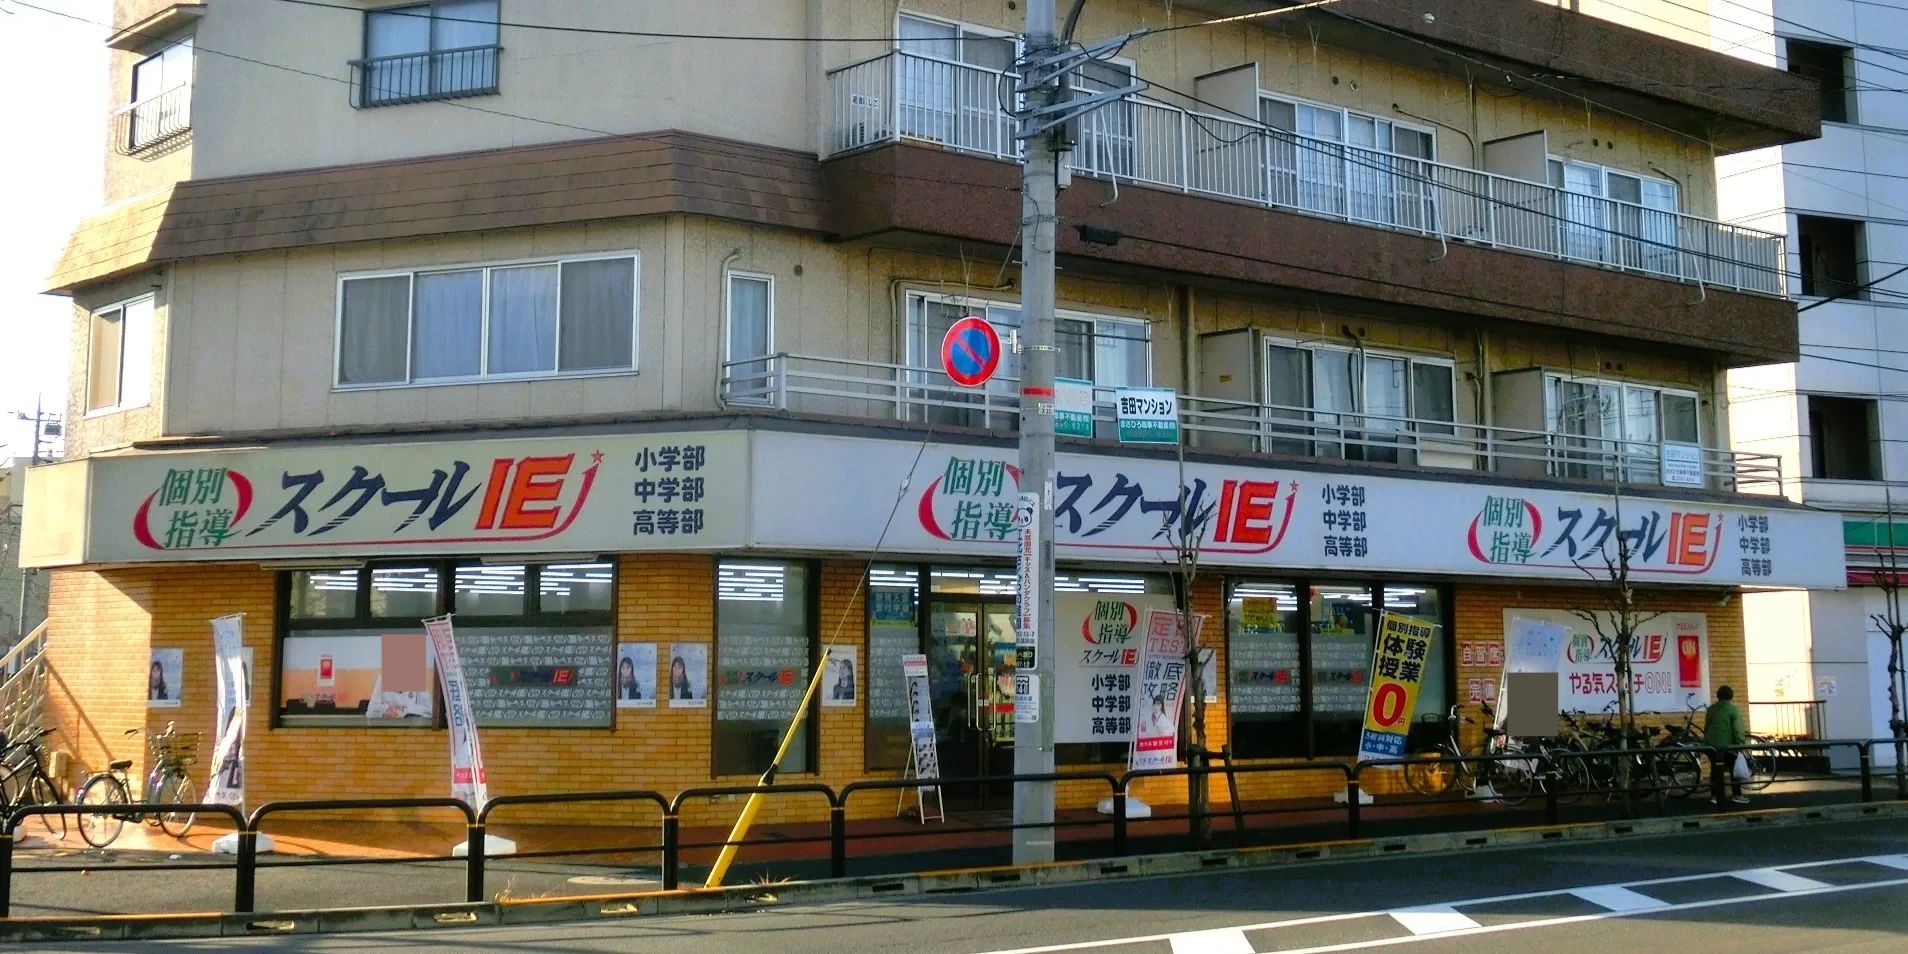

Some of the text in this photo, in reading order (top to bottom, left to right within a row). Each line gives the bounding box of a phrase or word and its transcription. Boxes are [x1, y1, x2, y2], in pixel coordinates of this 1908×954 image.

[1120, 397, 1172, 415] 吉田マンション
[634, 445, 706, 473] 小学部
[159, 467, 227, 507] 個別
[943, 455, 1006, 497] 個別
[245, 453, 575, 537] スクールIE
[633, 476, 705, 504] 中学部
[1321, 484, 1367, 507] 小学部
[951, 499, 1021, 541] 指導
[1055, 472, 1281, 545] スクールIE
[1483, 494, 1525, 528] 個別
[164, 508, 240, 549] 指導
[632, 508, 705, 536] 高等部
[1323, 509, 1367, 533] 中学部
[1737, 514, 1770, 535] 小学部
[1323, 535, 1368, 558] 高等部
[1490, 530, 1537, 565] 指導
[1540, 504, 1710, 568] スクールIE
[1738, 536, 1771, 555] 中学部
[1740, 557, 1772, 577] 高等部
[1095, 600, 1124, 621] 個別
[1099, 623, 1131, 644] 指導
[1387, 620, 1431, 638] 個別指導
[1080, 648, 1137, 665] スクールIE
[1383, 633, 1427, 661] 体験
[1145, 661, 1185, 681] 徹底
[1379, 656, 1421, 683] 授業
[1092, 673, 1131, 691] 小学部
[1143, 682, 1178, 701] 攻略
[1569, 671, 1673, 695] やる気スチON!
[1092, 695, 1131, 713] 中学部
[1092, 716, 1131, 735] 高等部
